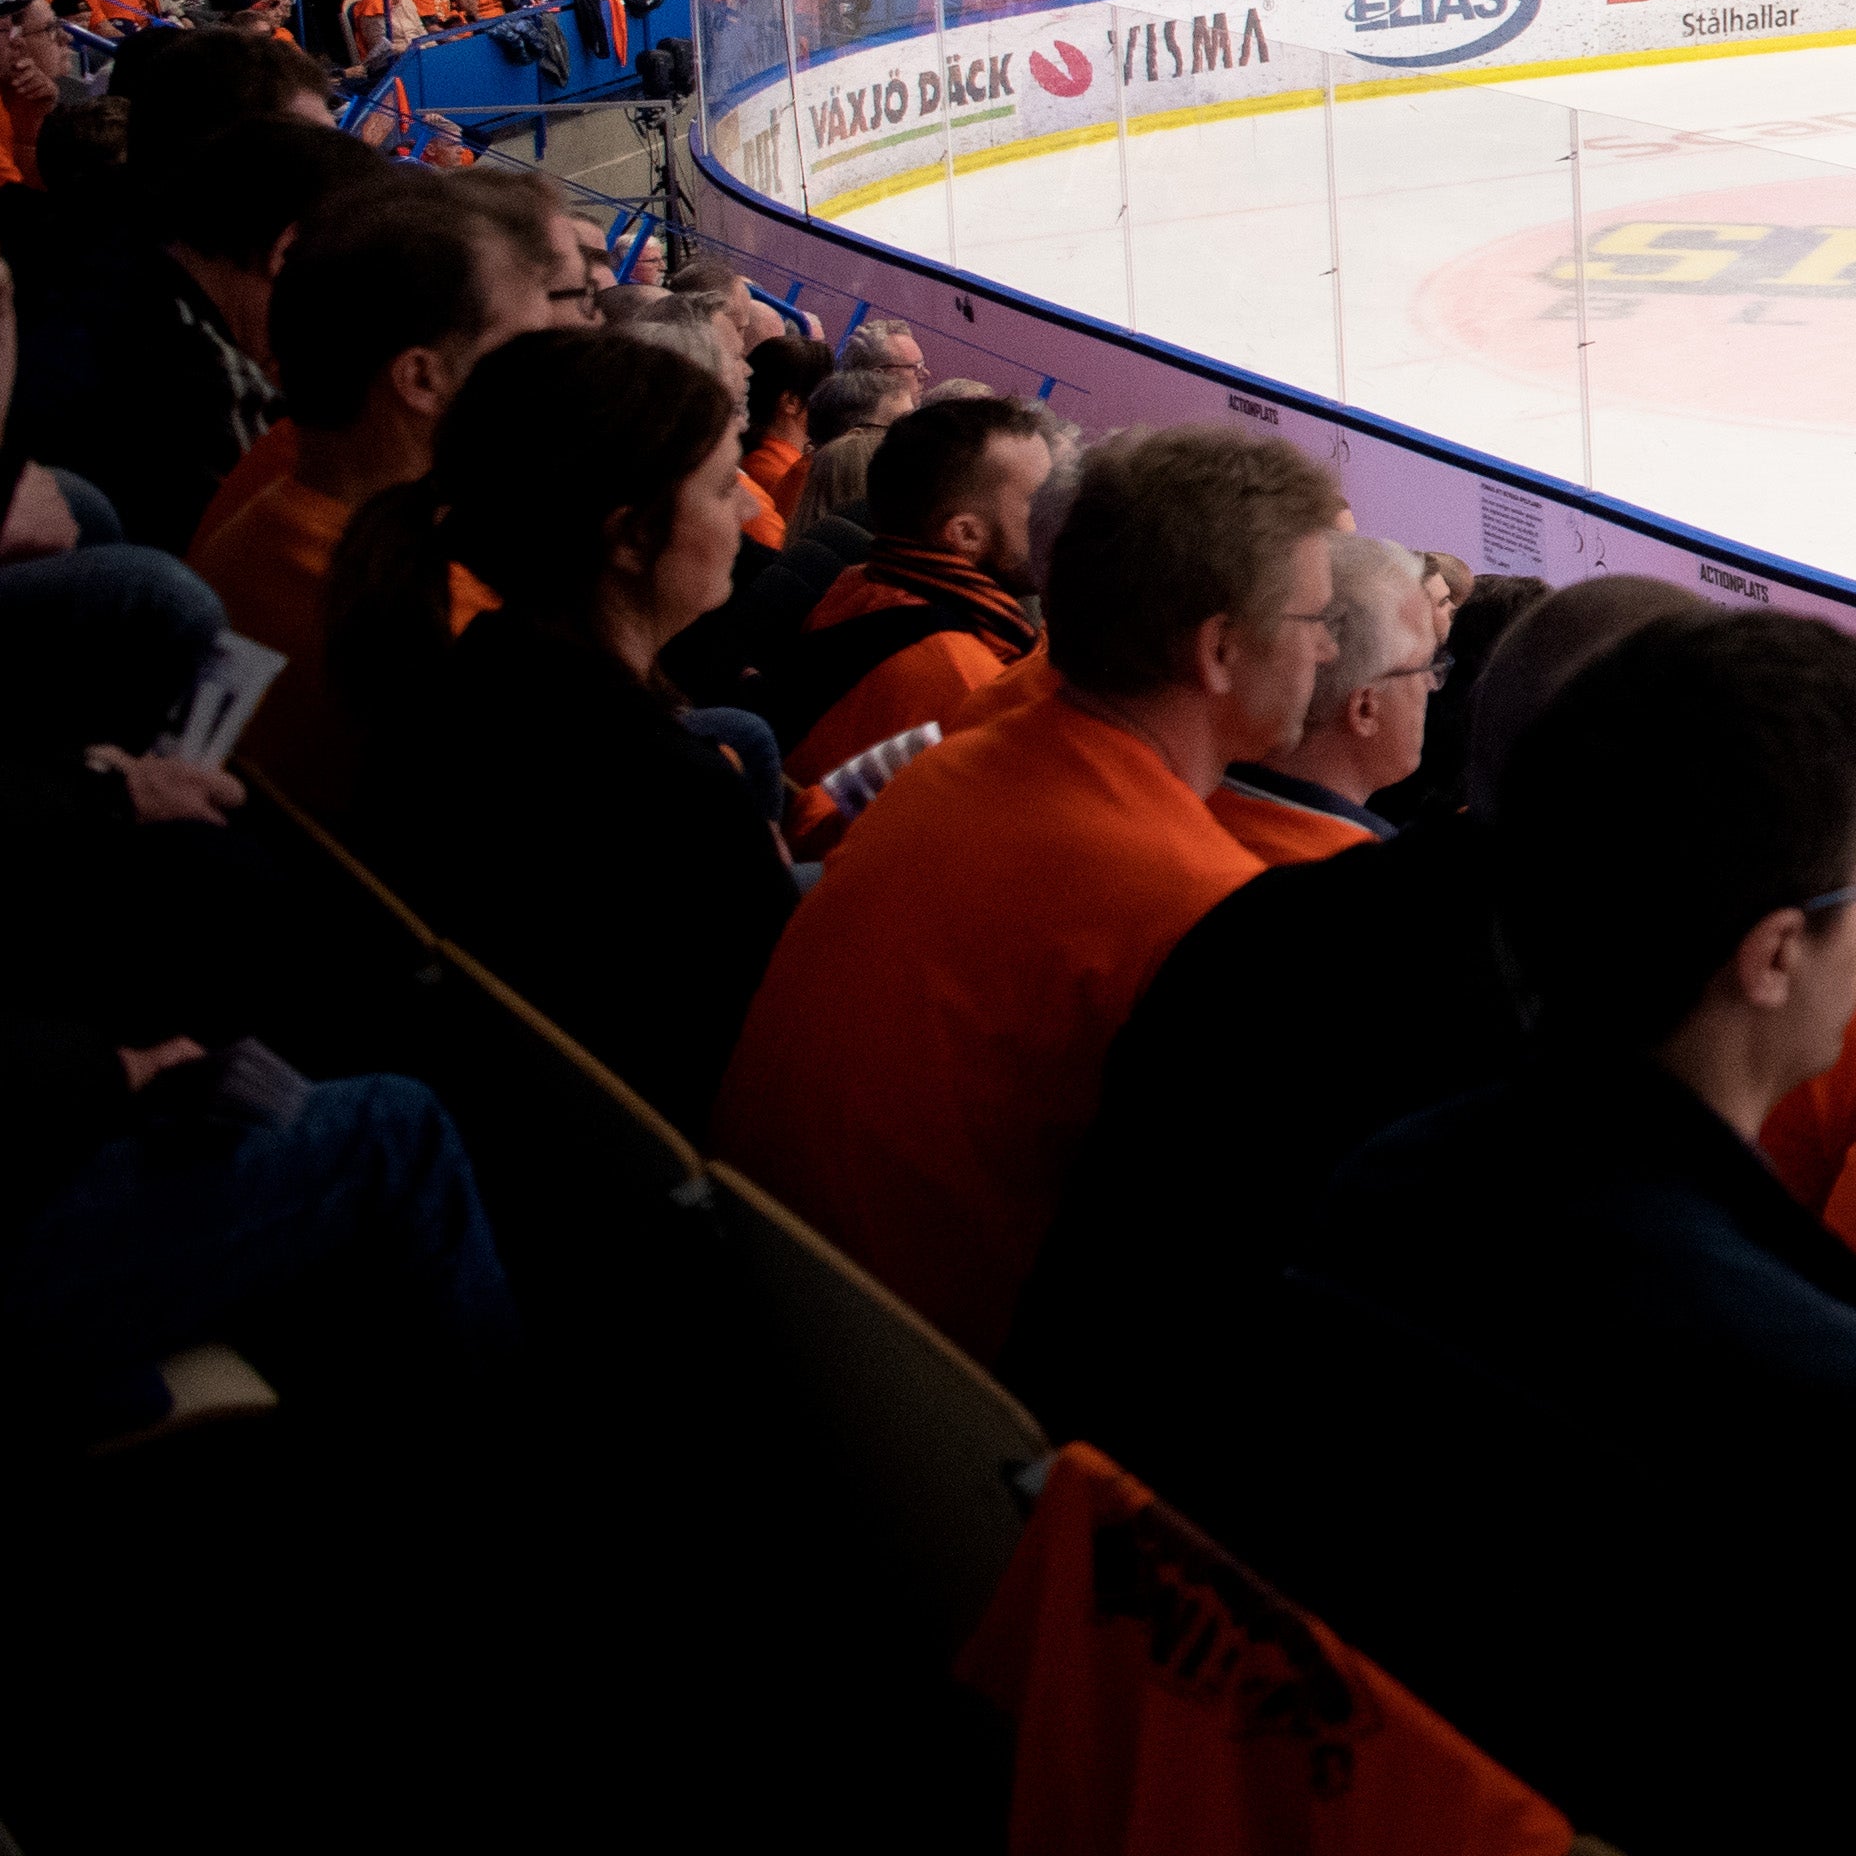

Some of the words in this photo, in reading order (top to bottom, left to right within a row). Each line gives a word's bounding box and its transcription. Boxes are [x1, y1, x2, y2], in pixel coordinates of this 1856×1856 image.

[1681, 4, 1800, 39] Stålhallar
[1106, 6, 1271, 87] VISMA
[809, 66, 910, 149] VÄXJÖ
[917, 52, 1015, 117] DÄCK
[1228, 393, 1280, 426] ACTIONPLATS
[1699, 563, 1771, 604] ACTIONPLATS
